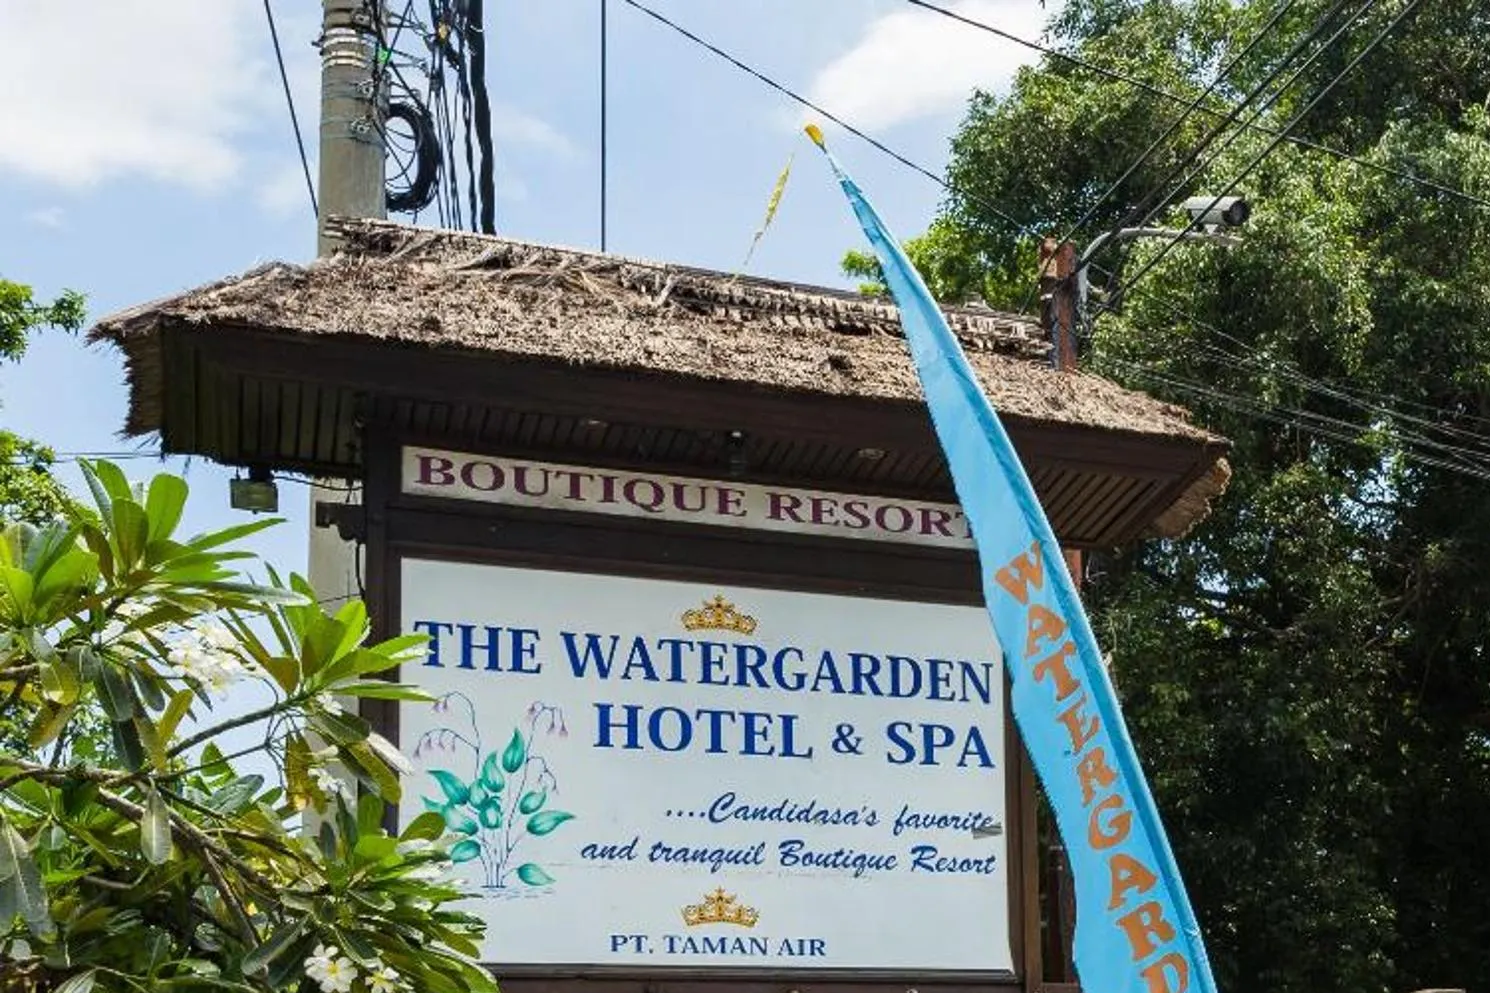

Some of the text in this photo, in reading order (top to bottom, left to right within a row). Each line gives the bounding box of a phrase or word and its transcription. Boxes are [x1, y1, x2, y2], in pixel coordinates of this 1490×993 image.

[415, 455, 748, 519] BOUTIQUE
[413, 620, 994, 704] THE WATERGARDEN
[592, 702, 996, 769] HOTEL & SPA
[892, 804, 995, 836] favorite
[580, 836, 997, 877] and tranquil Boutique Resort
[610, 934, 827, 957] PT. TAMAN AIR
